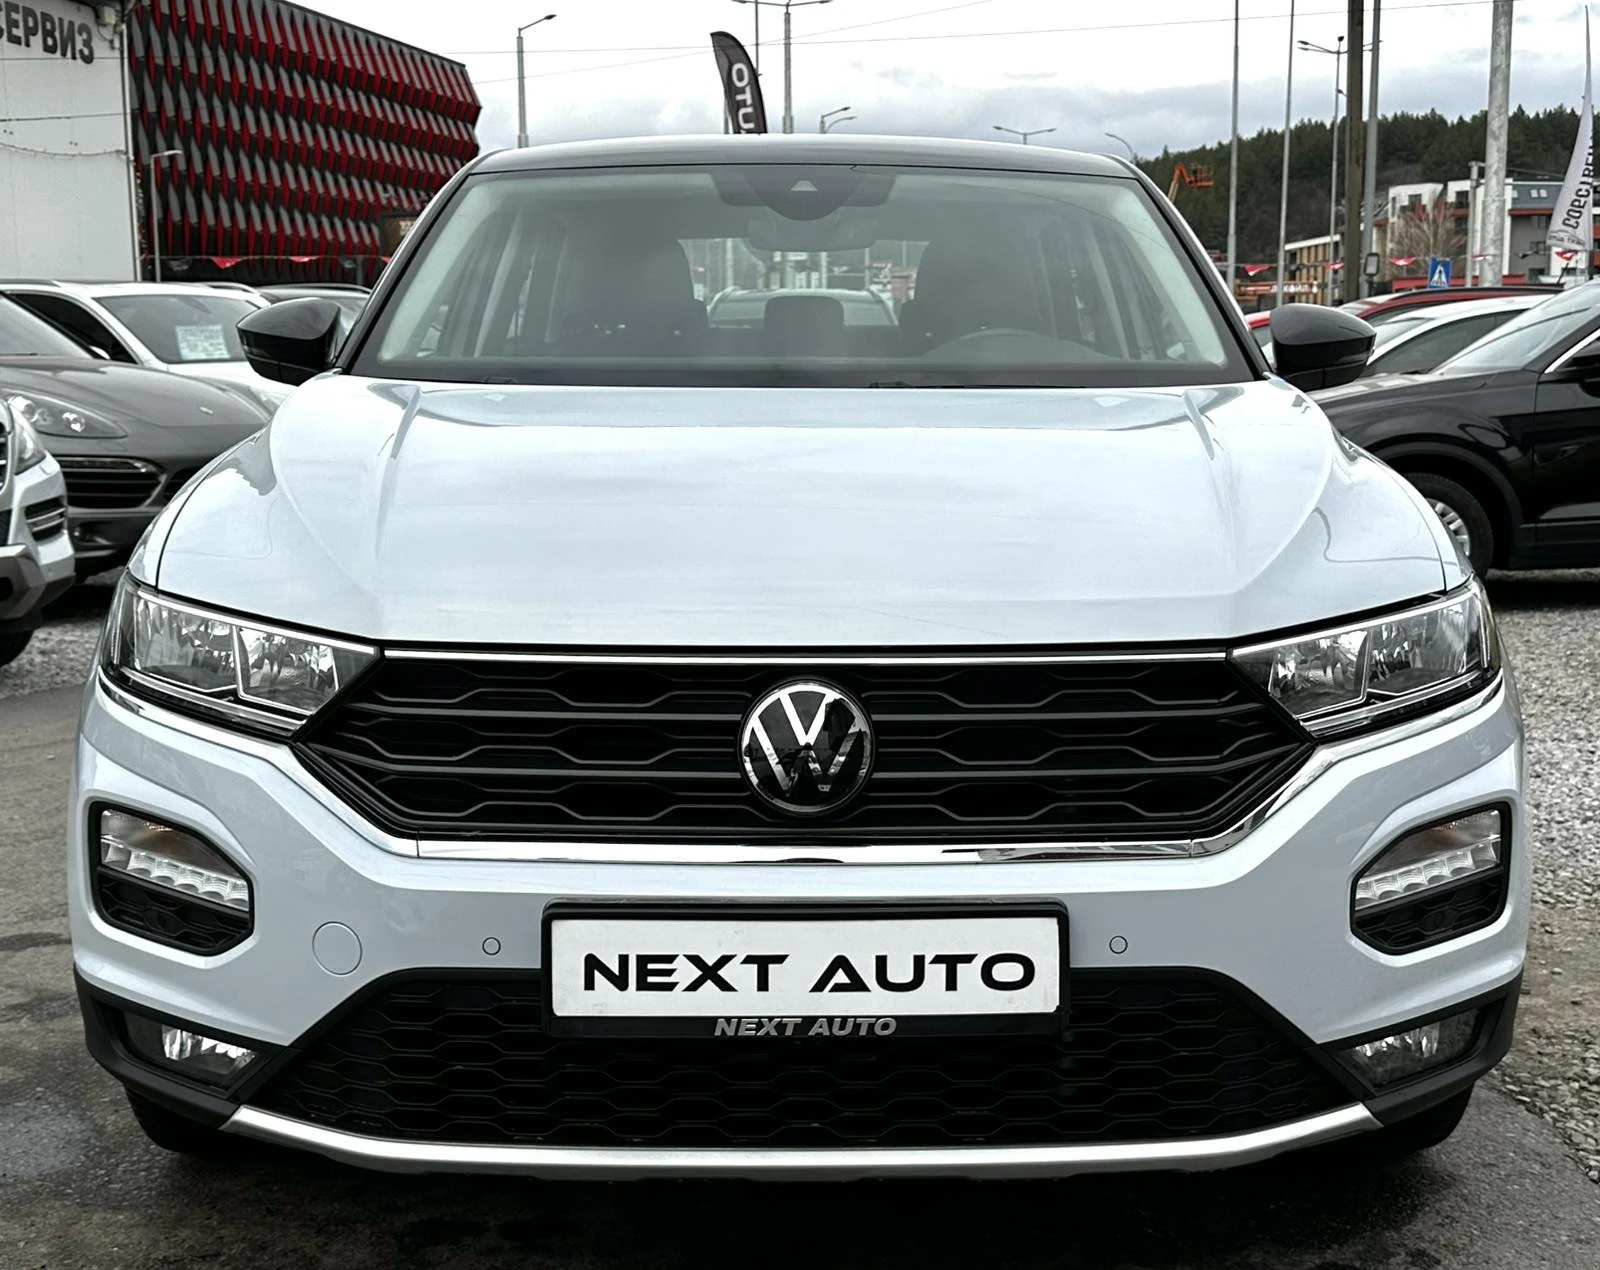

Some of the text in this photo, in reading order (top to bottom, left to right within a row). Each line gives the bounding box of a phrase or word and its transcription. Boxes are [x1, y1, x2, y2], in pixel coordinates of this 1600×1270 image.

[0, 1, 94, 64] ЕРВИЗ
[584, 953, 1036, 992] NEXT AUTO
[714, 1017, 897, 1036] NEXT AUTO
